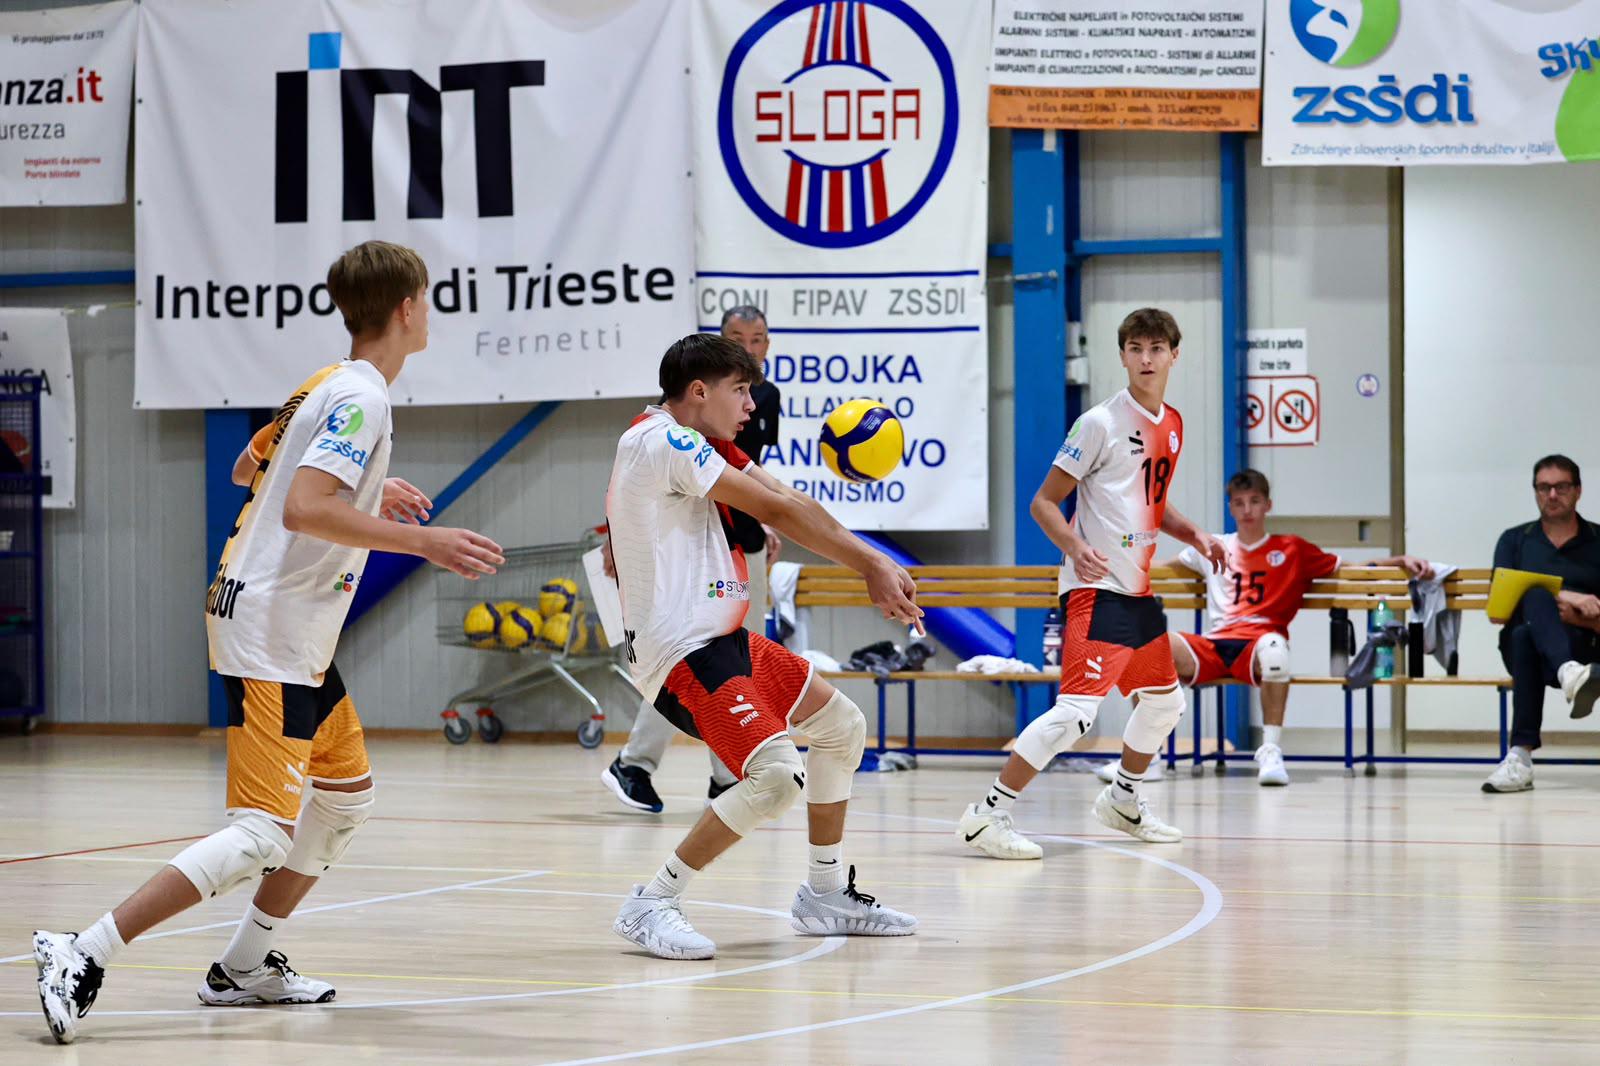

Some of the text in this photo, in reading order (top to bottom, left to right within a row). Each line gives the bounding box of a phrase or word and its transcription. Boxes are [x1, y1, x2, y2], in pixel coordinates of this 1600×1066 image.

[998, 26, 1042, 36] ALARMNI
[1045, 28, 1079, 37] SISTEMI
[1088, 27, 1135, 37] KLIMATSKE
[1138, 28, 1182, 38] NAPRAVE
[1208, 13, 1244, 22] SISTEMI
[994, 64, 1035, 73] IMPIANTI
[1048, 65, 1124, 75] CLIMATIZZAZIONE
[1134, 65, 1197, 75] AUTOMATISMI
[1216, 66, 1256, 76] CANCELLI
[995, 48, 1037, 57] IMPIANTI
[1040, 49, 1082, 59] ELETTRICI
[1092, 49, 1157, 59] FOTOVOLTAICI
[1167, 50, 1202, 59] SISTEMI
[1216, 50, 1256, 59] ALLARME
[0, 67, 104, 106] nza.it
[756, 89, 920, 142] SLOGA
[155, 263, 675, 328] Interpo di Trieste
[792, 288, 867, 316] FIPAV
[888, 281, 965, 315] ZSŠDI
[475, 323, 622, 357] Fernetti
[1141, 456, 1171, 506] 18
[1231, 571, 1267, 605] 15
[739, 710, 760, 727] nine
